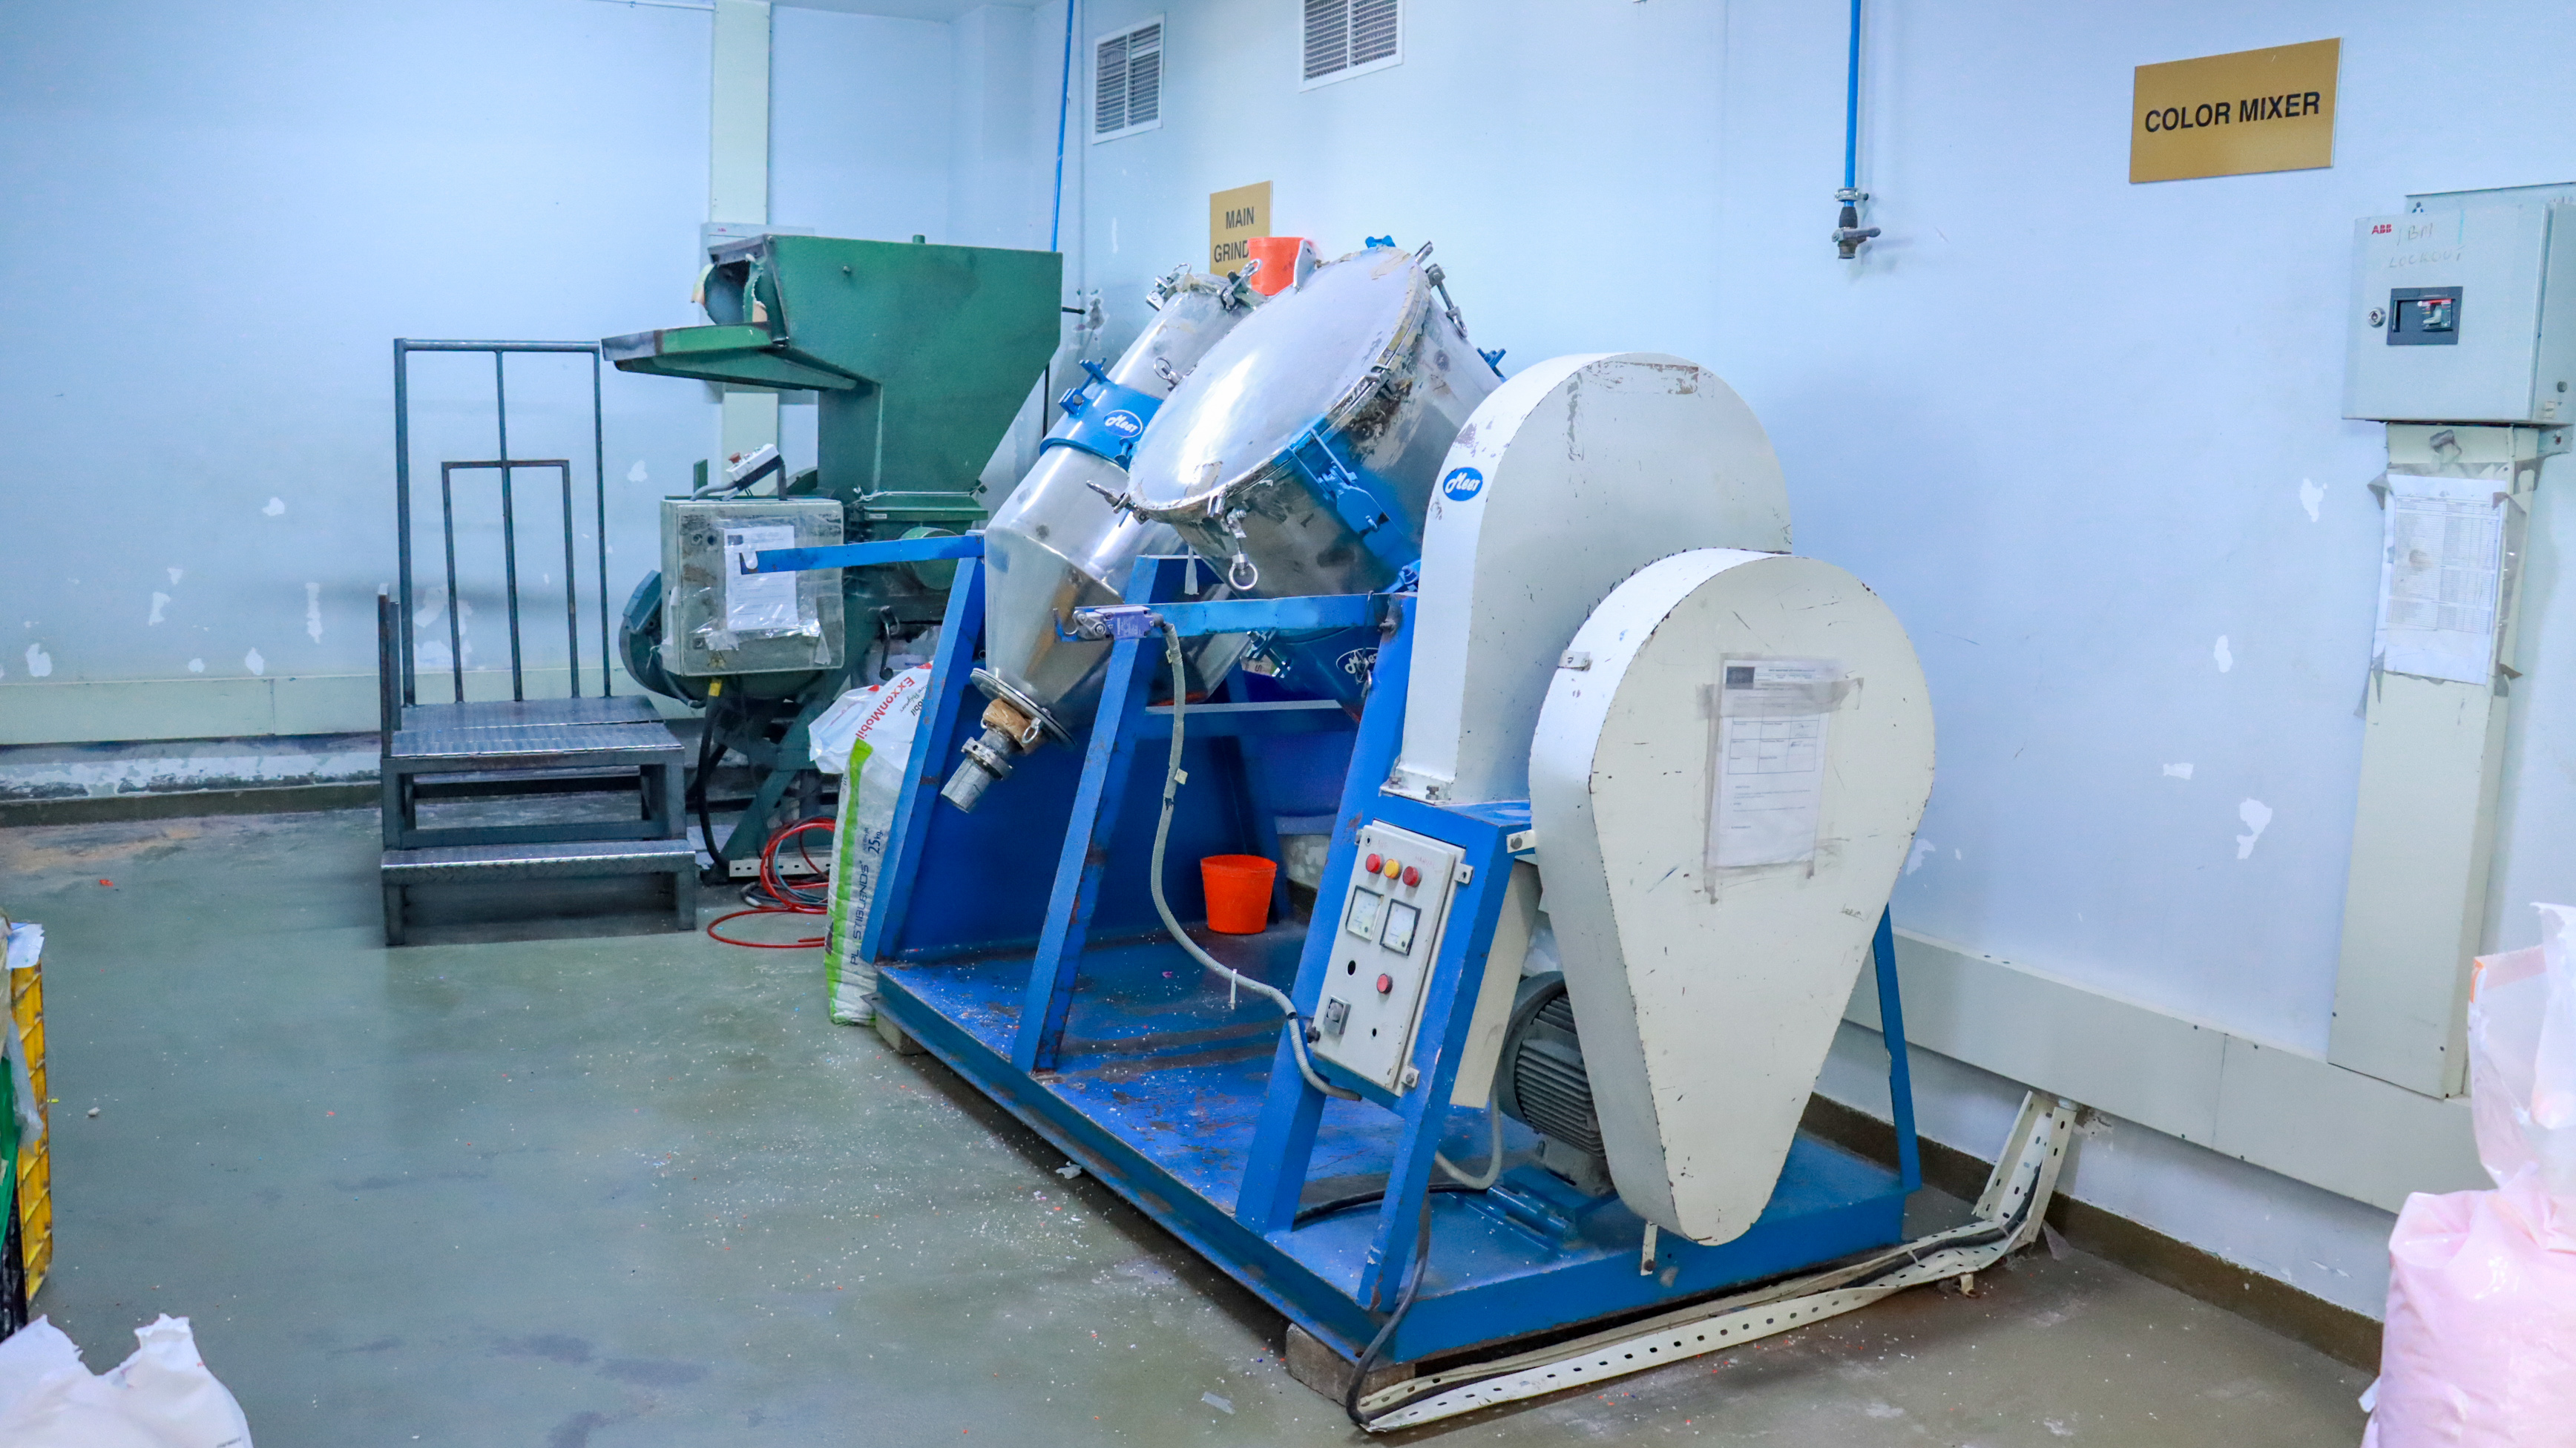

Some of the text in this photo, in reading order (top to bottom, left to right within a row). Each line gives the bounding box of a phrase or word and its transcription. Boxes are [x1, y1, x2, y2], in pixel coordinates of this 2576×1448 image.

[2145, 90, 2321, 133] COLOR MIXER
[1226, 206, 1255, 230] MAIN
[2371, 223, 2393, 235] ABB
[1214, 240, 1249, 263] GRIND
[855, 676, 916, 740] ExxonMobil
